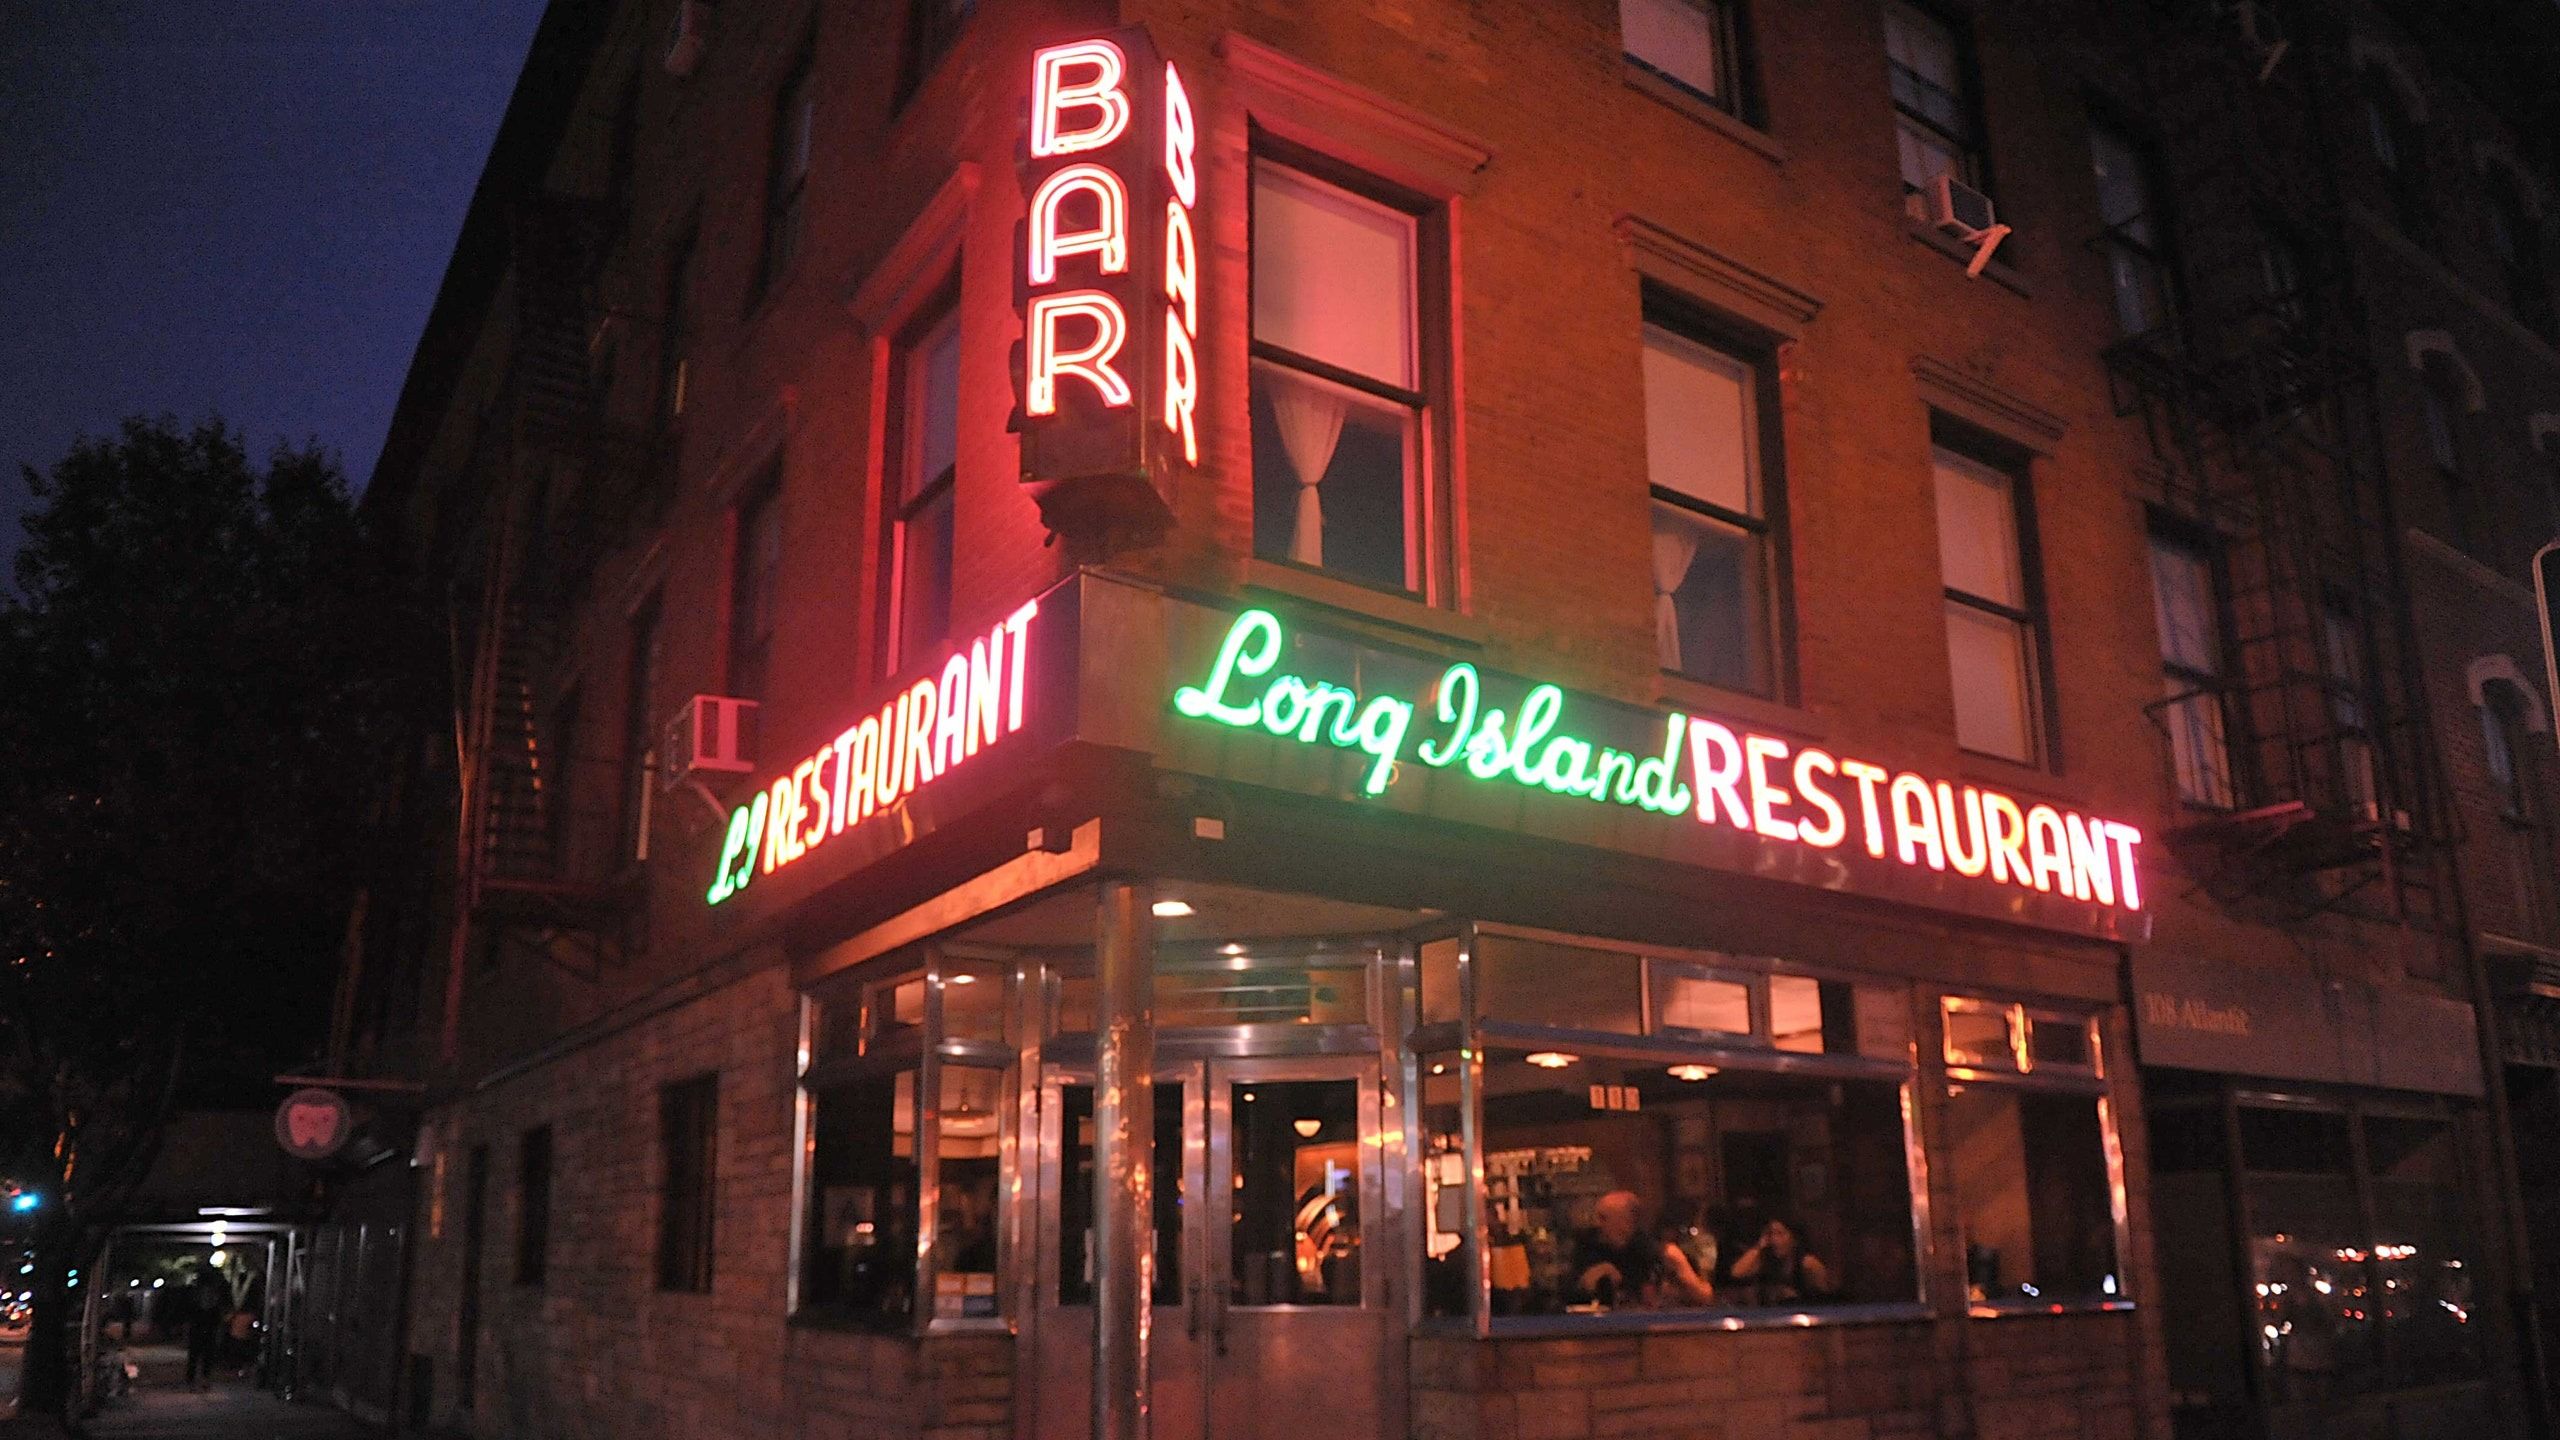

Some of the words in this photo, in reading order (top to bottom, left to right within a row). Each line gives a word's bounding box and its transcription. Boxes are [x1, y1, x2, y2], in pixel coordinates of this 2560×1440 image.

[1027, 38, 1133, 417] BAR
[1166, 60, 1197, 468] BAR
[763, 597, 1038, 875] RESTAURANT
[1174, 609, 1413, 794] Long
[1418, 663, 1691, 816] Island
[1688, 716, 2142, 911] RESTAURANT
